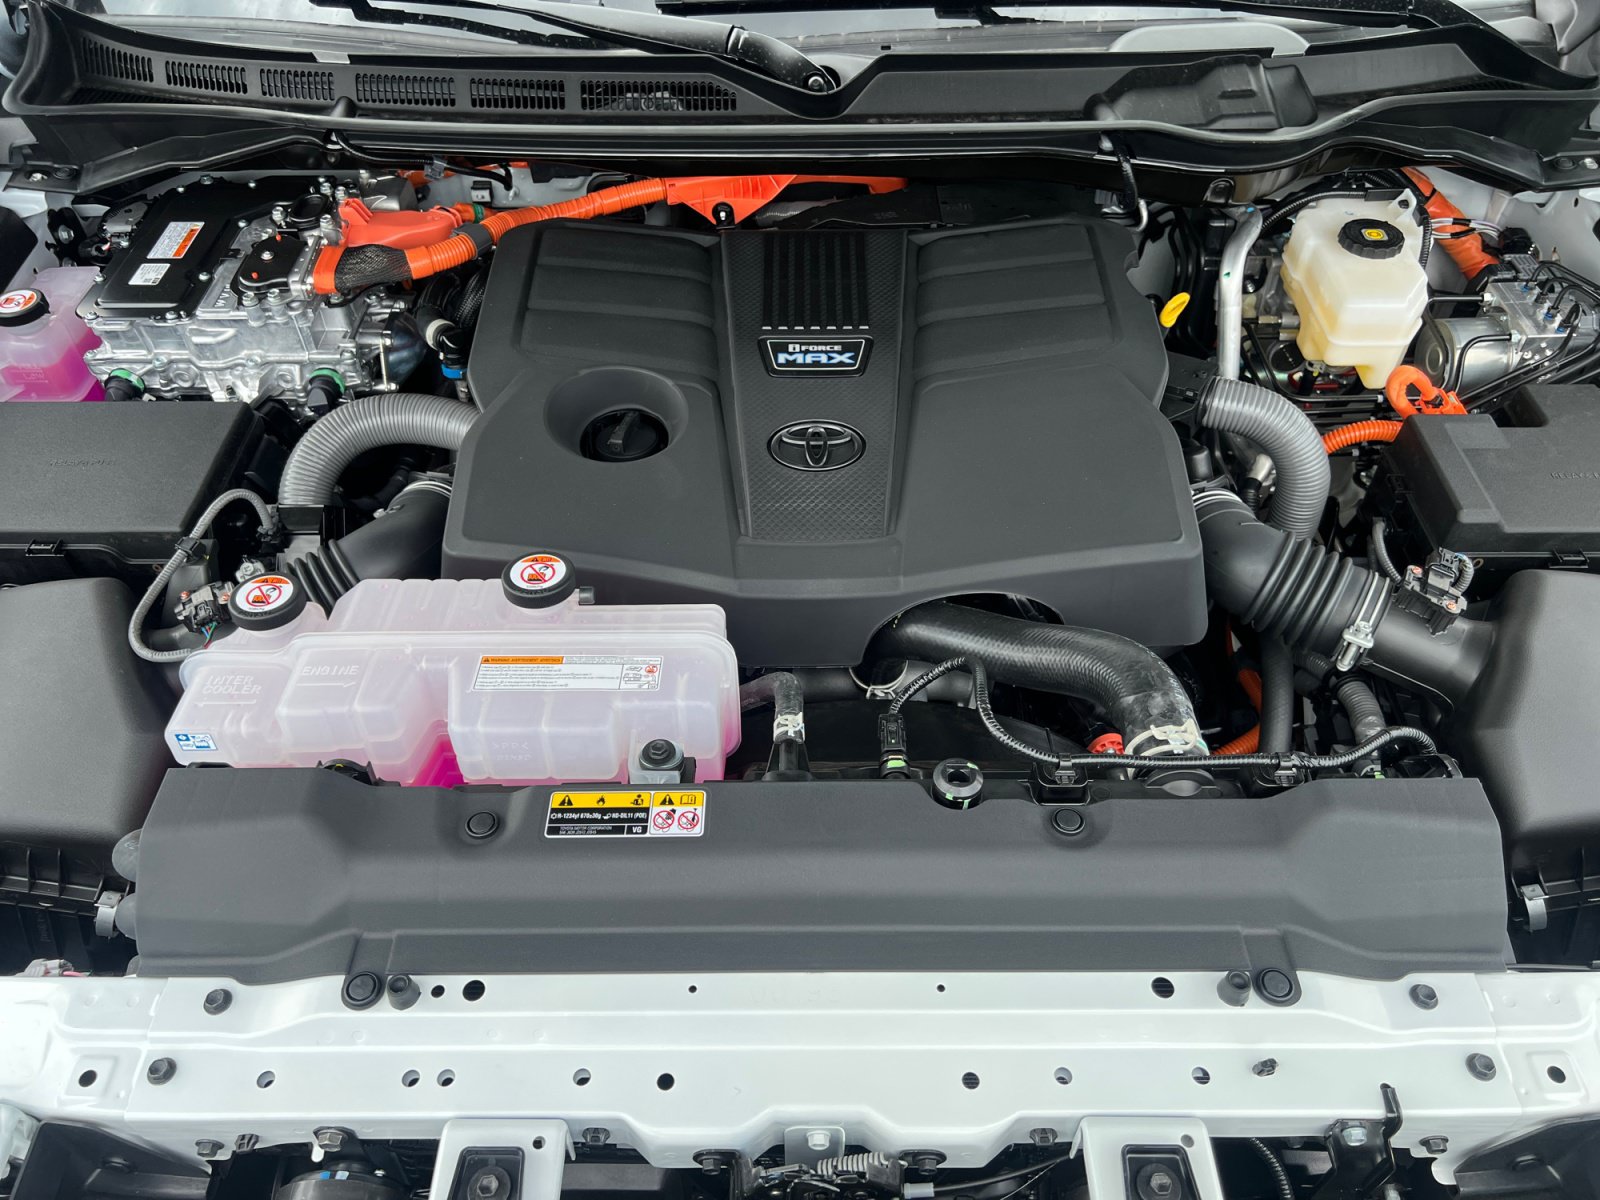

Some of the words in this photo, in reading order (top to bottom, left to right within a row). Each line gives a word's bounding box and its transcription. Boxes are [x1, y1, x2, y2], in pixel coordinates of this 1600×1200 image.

[777, 352, 855, 364] MAX
[302, 665, 360, 676] ENGINE
[206, 675, 254, 685] INTER
[202, 684, 262, 695] COOLER
